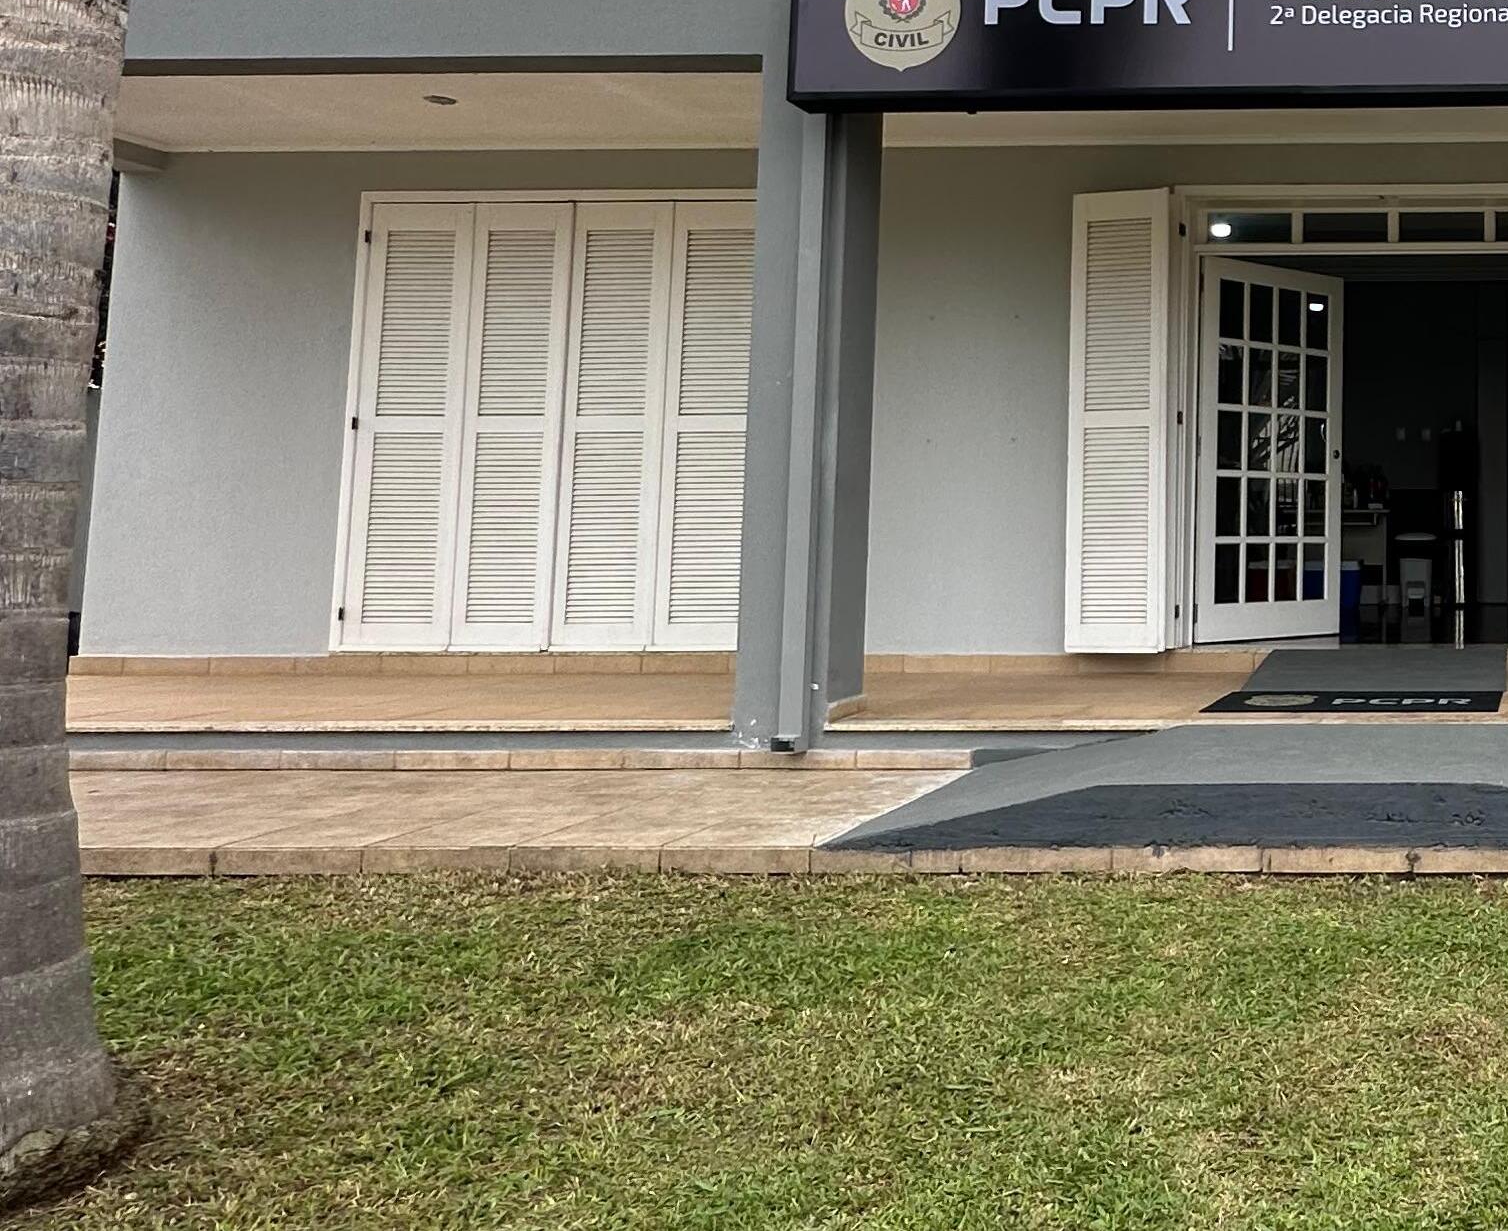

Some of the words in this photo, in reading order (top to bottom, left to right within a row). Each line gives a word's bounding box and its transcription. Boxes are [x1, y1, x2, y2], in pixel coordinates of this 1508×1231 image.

[1269, 4, 1295, 25] 2ª
[1301, 2, 1413, 29] Delegacia
[873, 31, 930, 48] CIVIL
